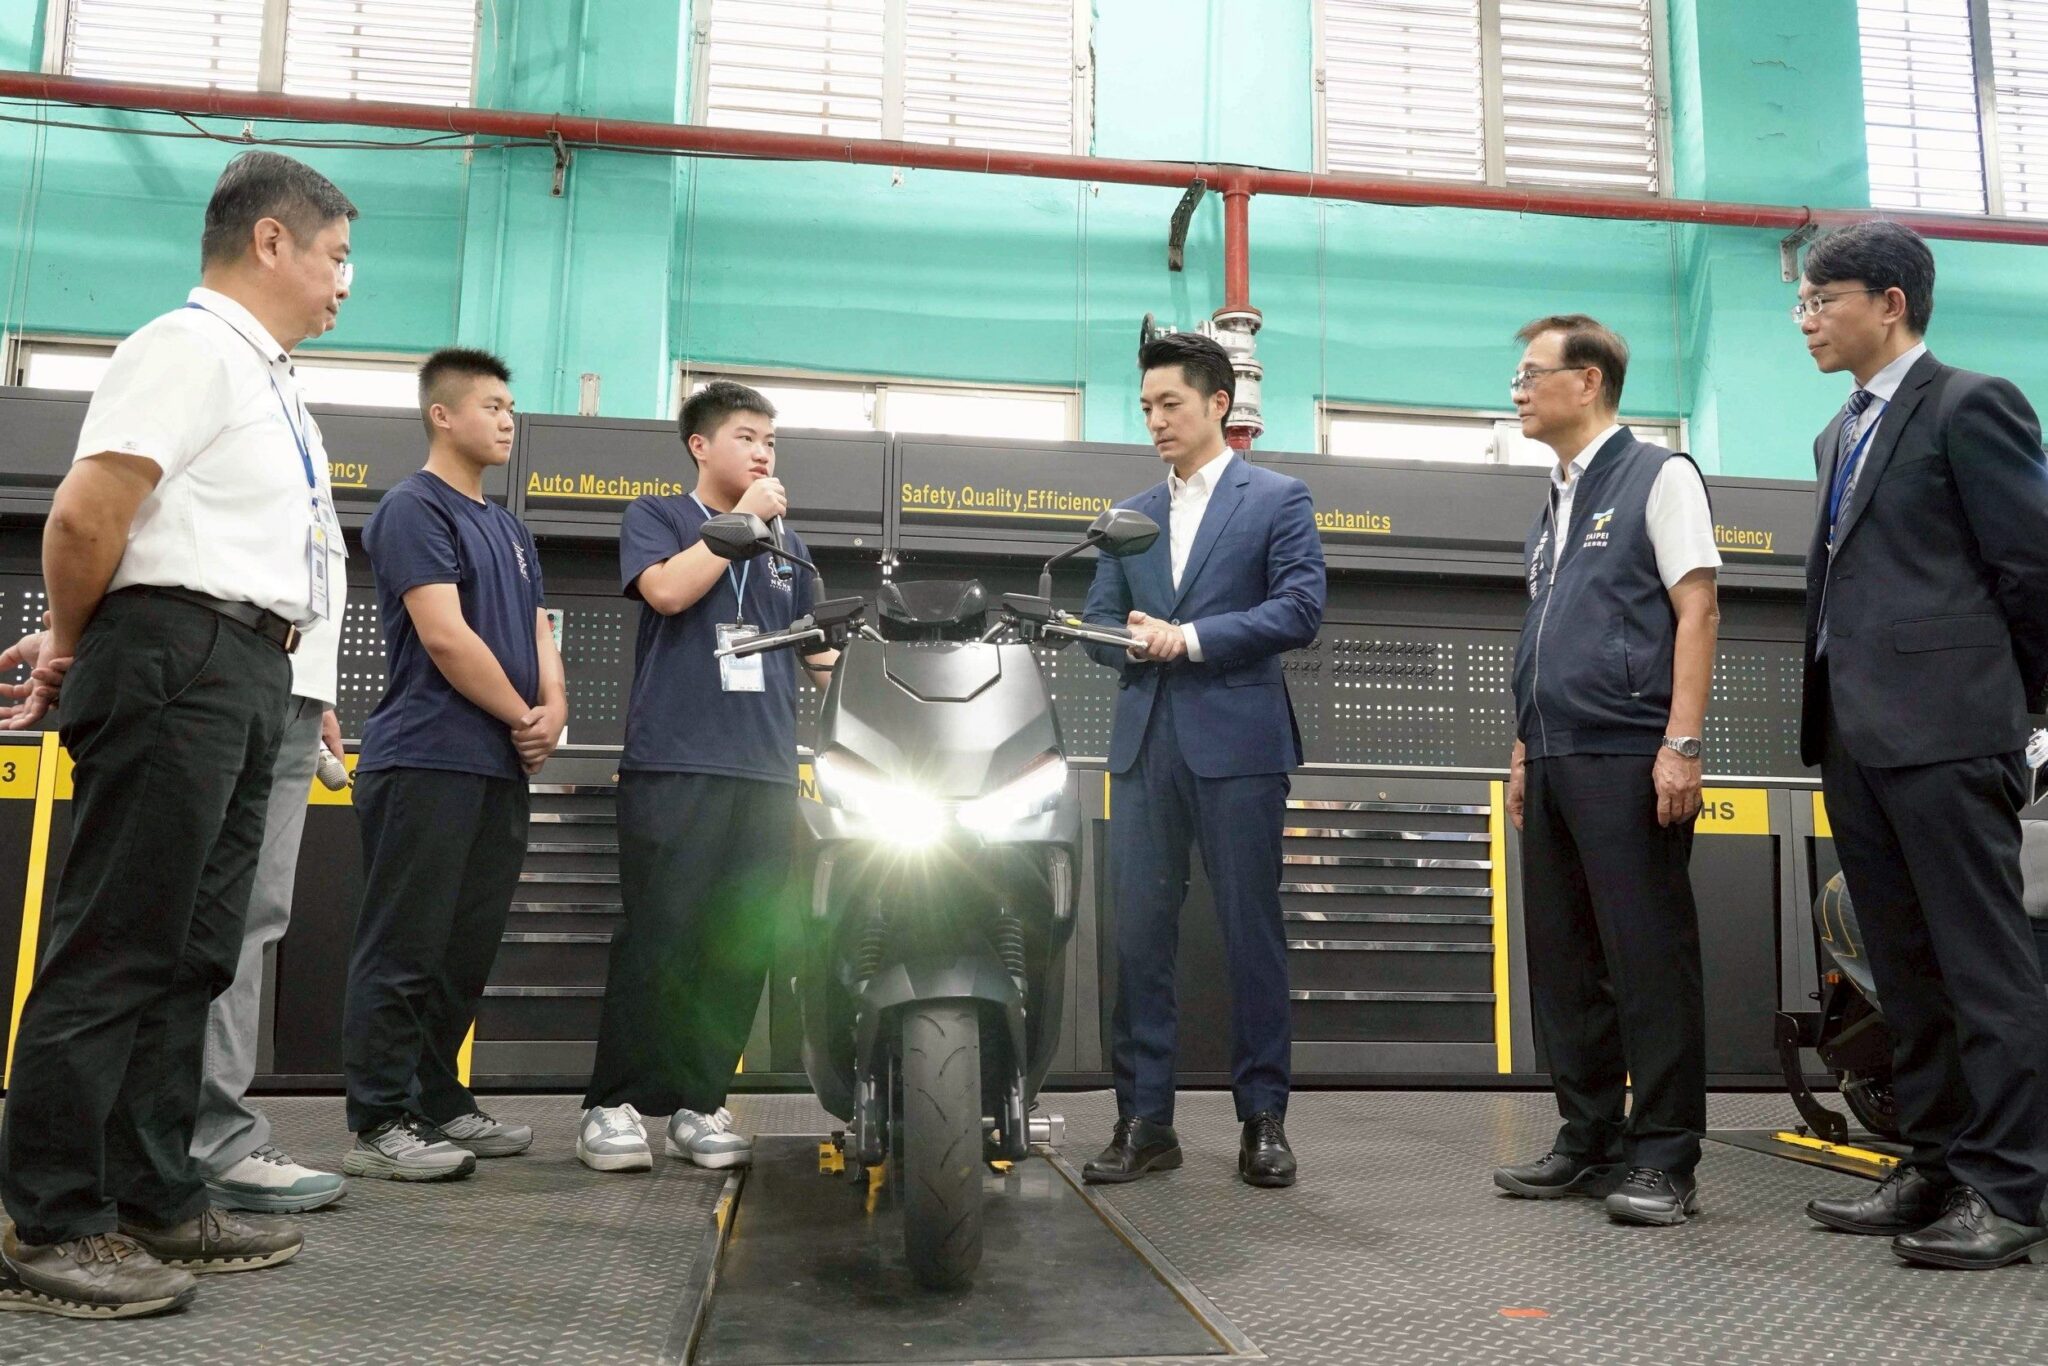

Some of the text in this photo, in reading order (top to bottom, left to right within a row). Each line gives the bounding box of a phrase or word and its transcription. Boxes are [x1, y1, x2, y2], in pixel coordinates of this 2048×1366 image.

[527, 471, 683, 497] Auto Mechanics
[901, 483, 1112, 513] Safety,Quality,Efficiency
[1314, 508, 1391, 530] echanics
[1585, 531, 1610, 541] TAIPEI
[1714, 524, 1773, 550] ficiency
[2, 761, 16, 783] 3
[1700, 801, 1735, 821] HS
